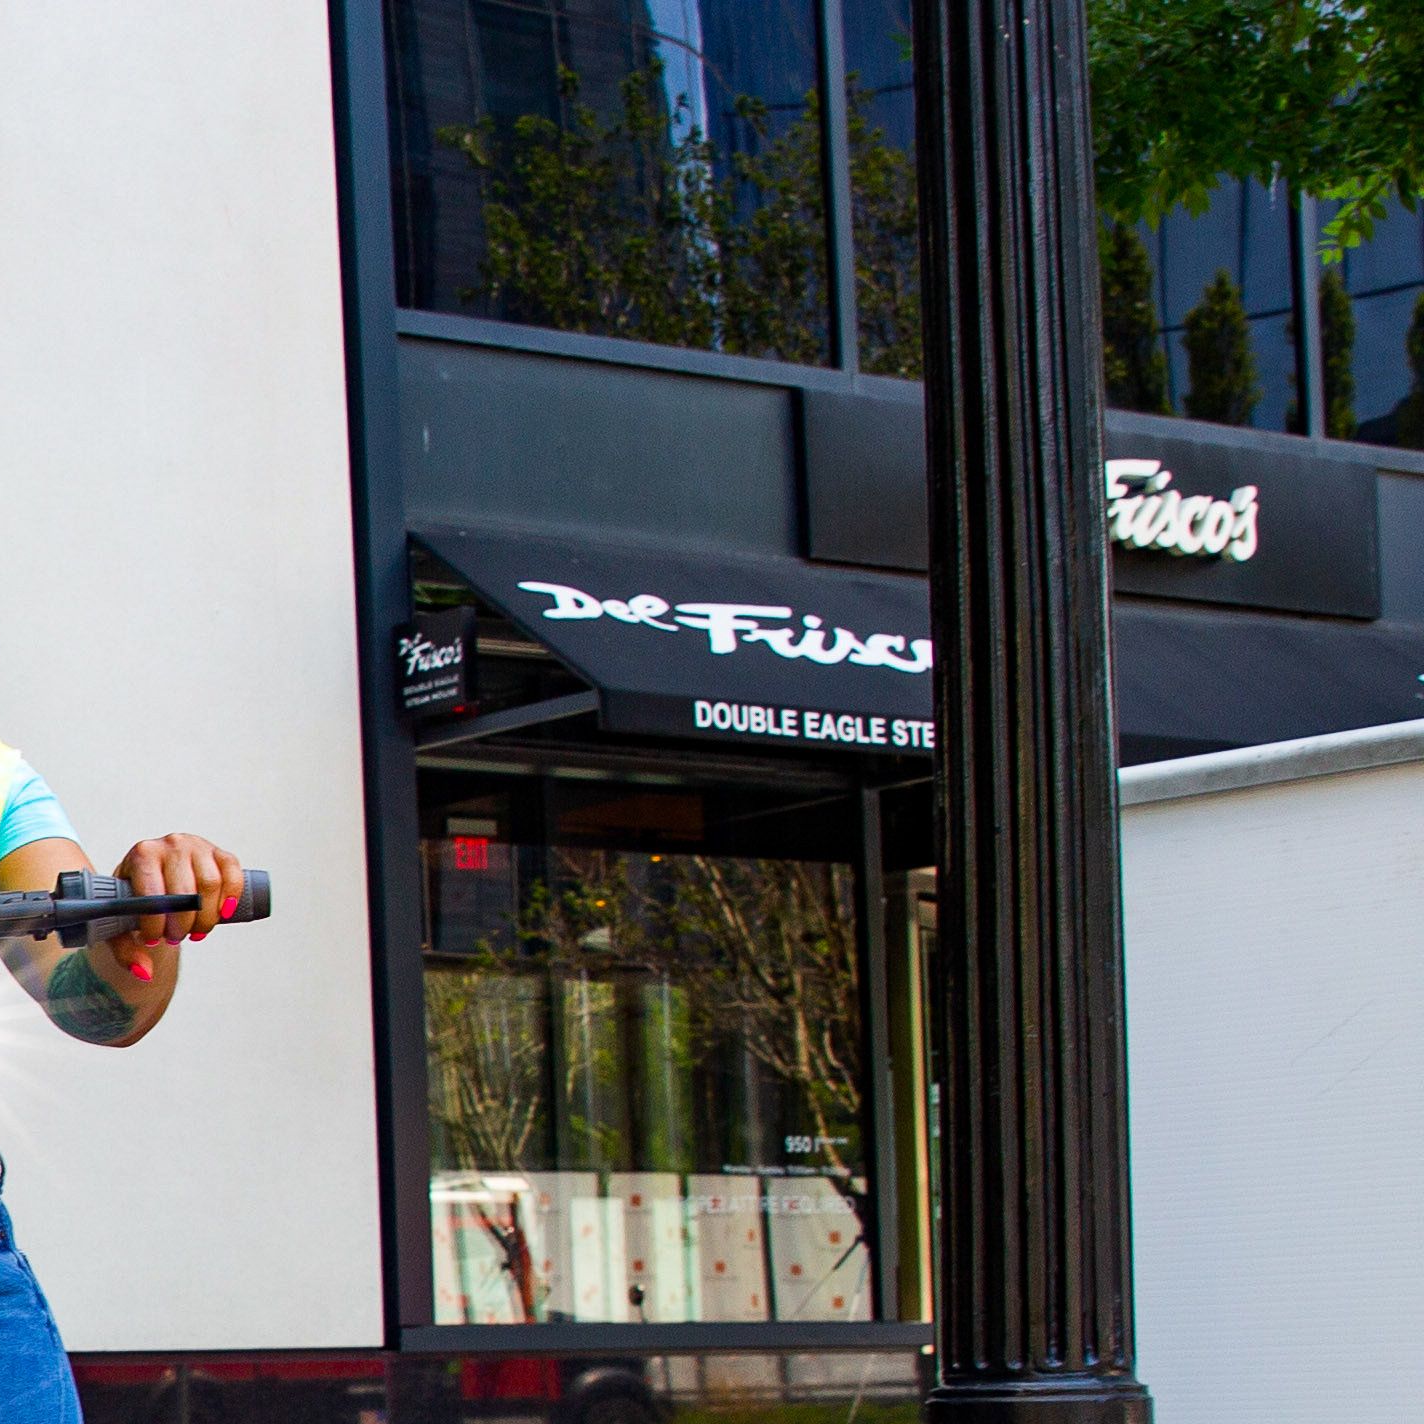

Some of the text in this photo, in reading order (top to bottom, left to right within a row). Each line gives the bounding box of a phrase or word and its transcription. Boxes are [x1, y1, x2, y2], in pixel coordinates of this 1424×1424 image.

[517, 580, 680, 631] Del
[695, 700, 798, 738] DOUBLE
[804, 711, 888, 744] EAGLE
